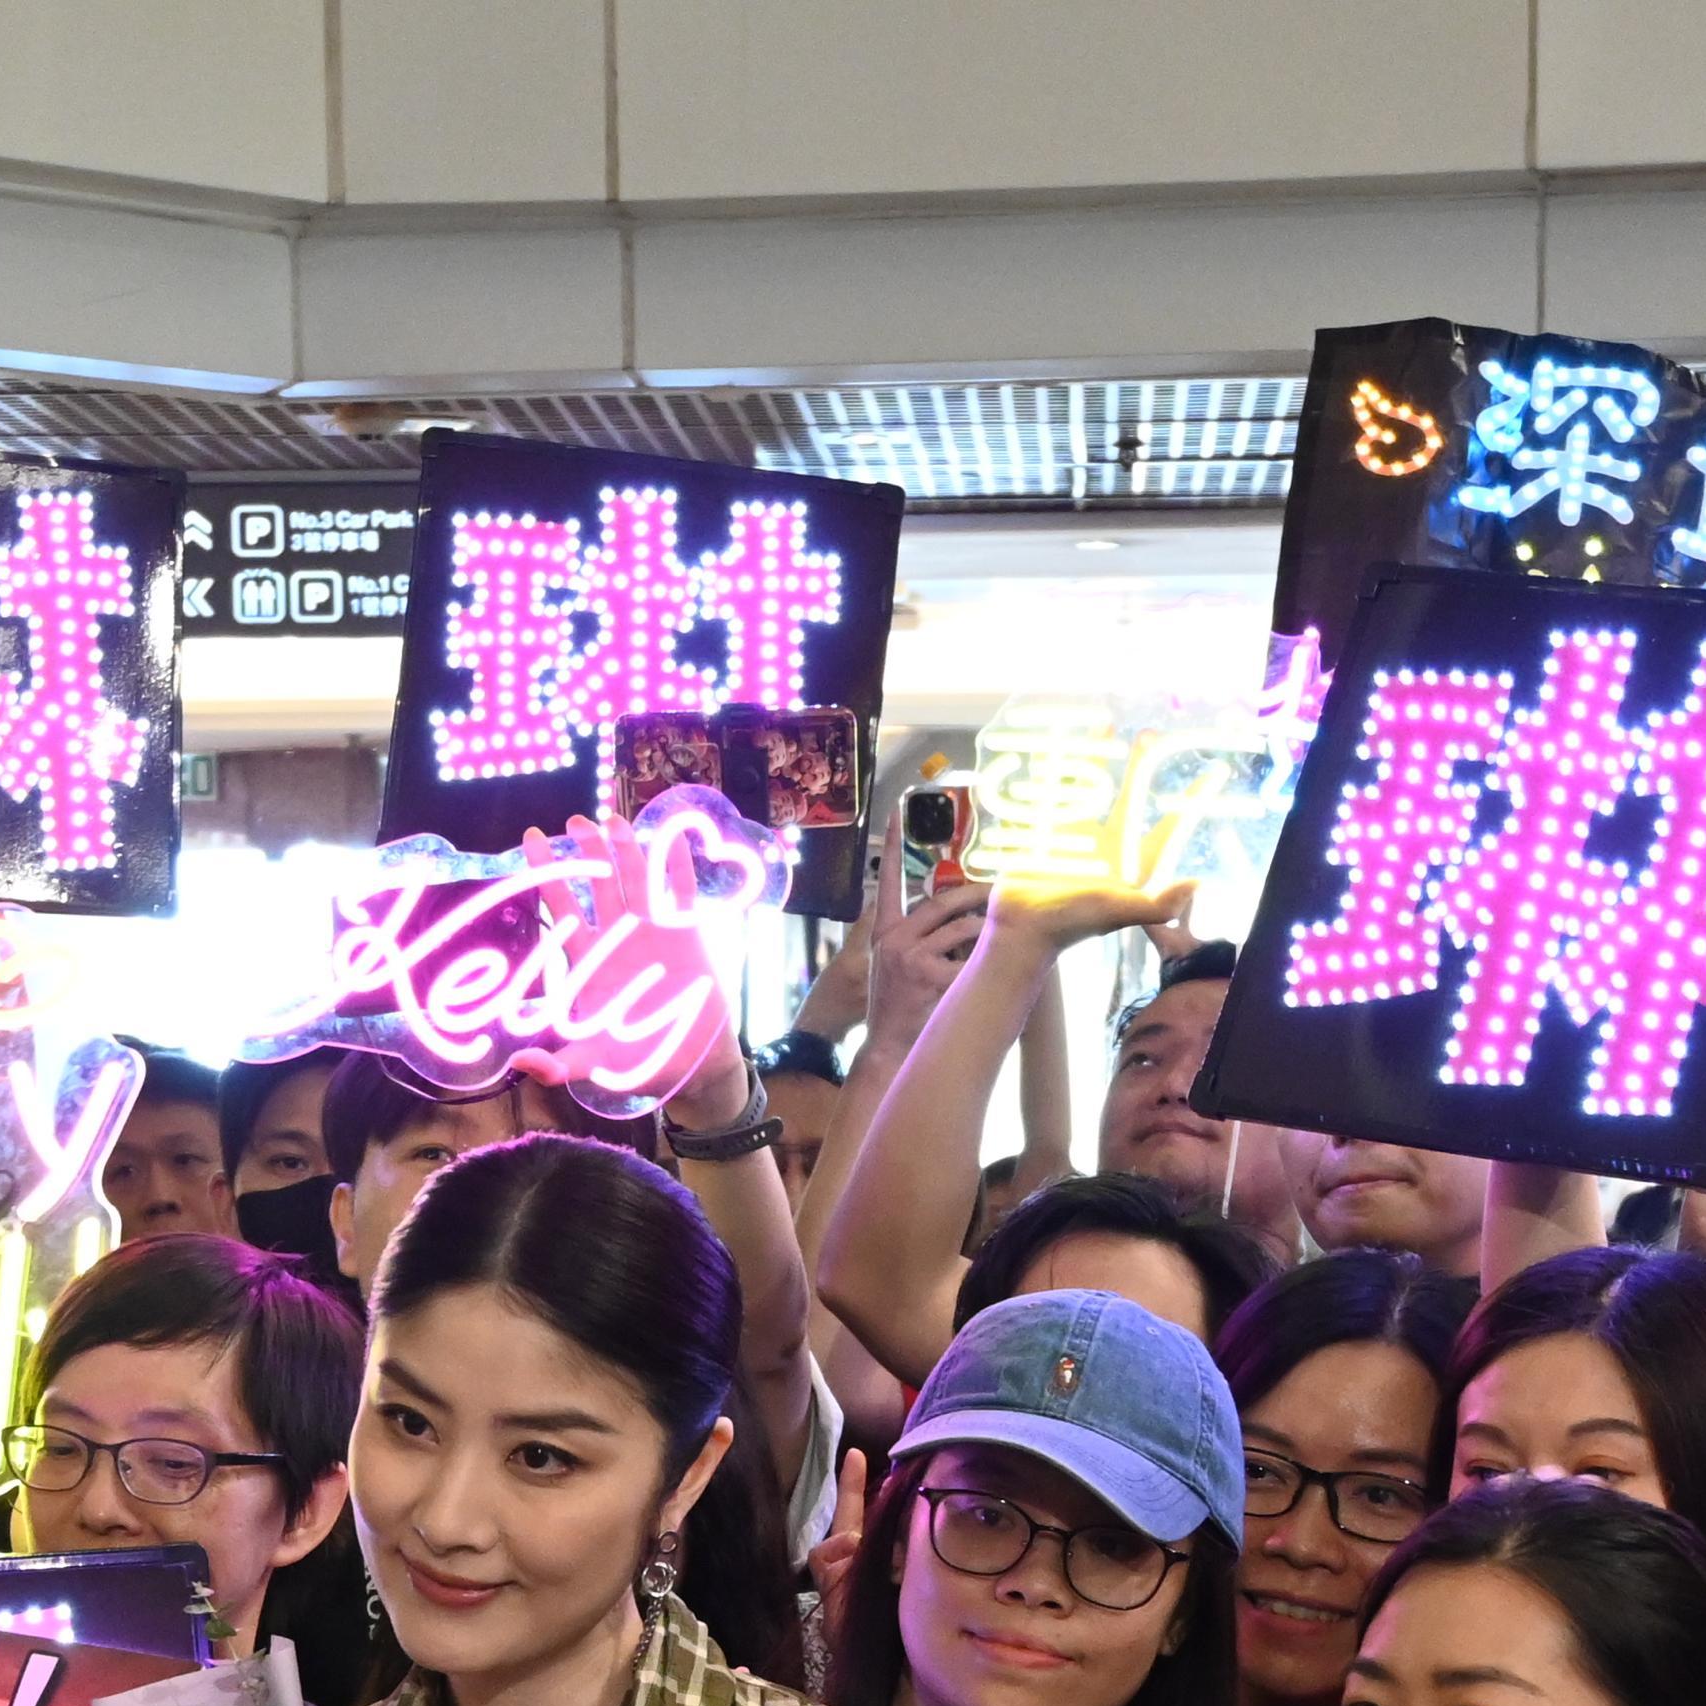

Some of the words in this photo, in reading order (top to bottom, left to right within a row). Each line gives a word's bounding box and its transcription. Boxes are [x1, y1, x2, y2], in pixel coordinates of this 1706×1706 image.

[289, 511, 334, 529] No.3
[336, 511, 368, 530] Car
[370, 510, 414, 529] Park
[298, 852, 715, 1092] Kelly
